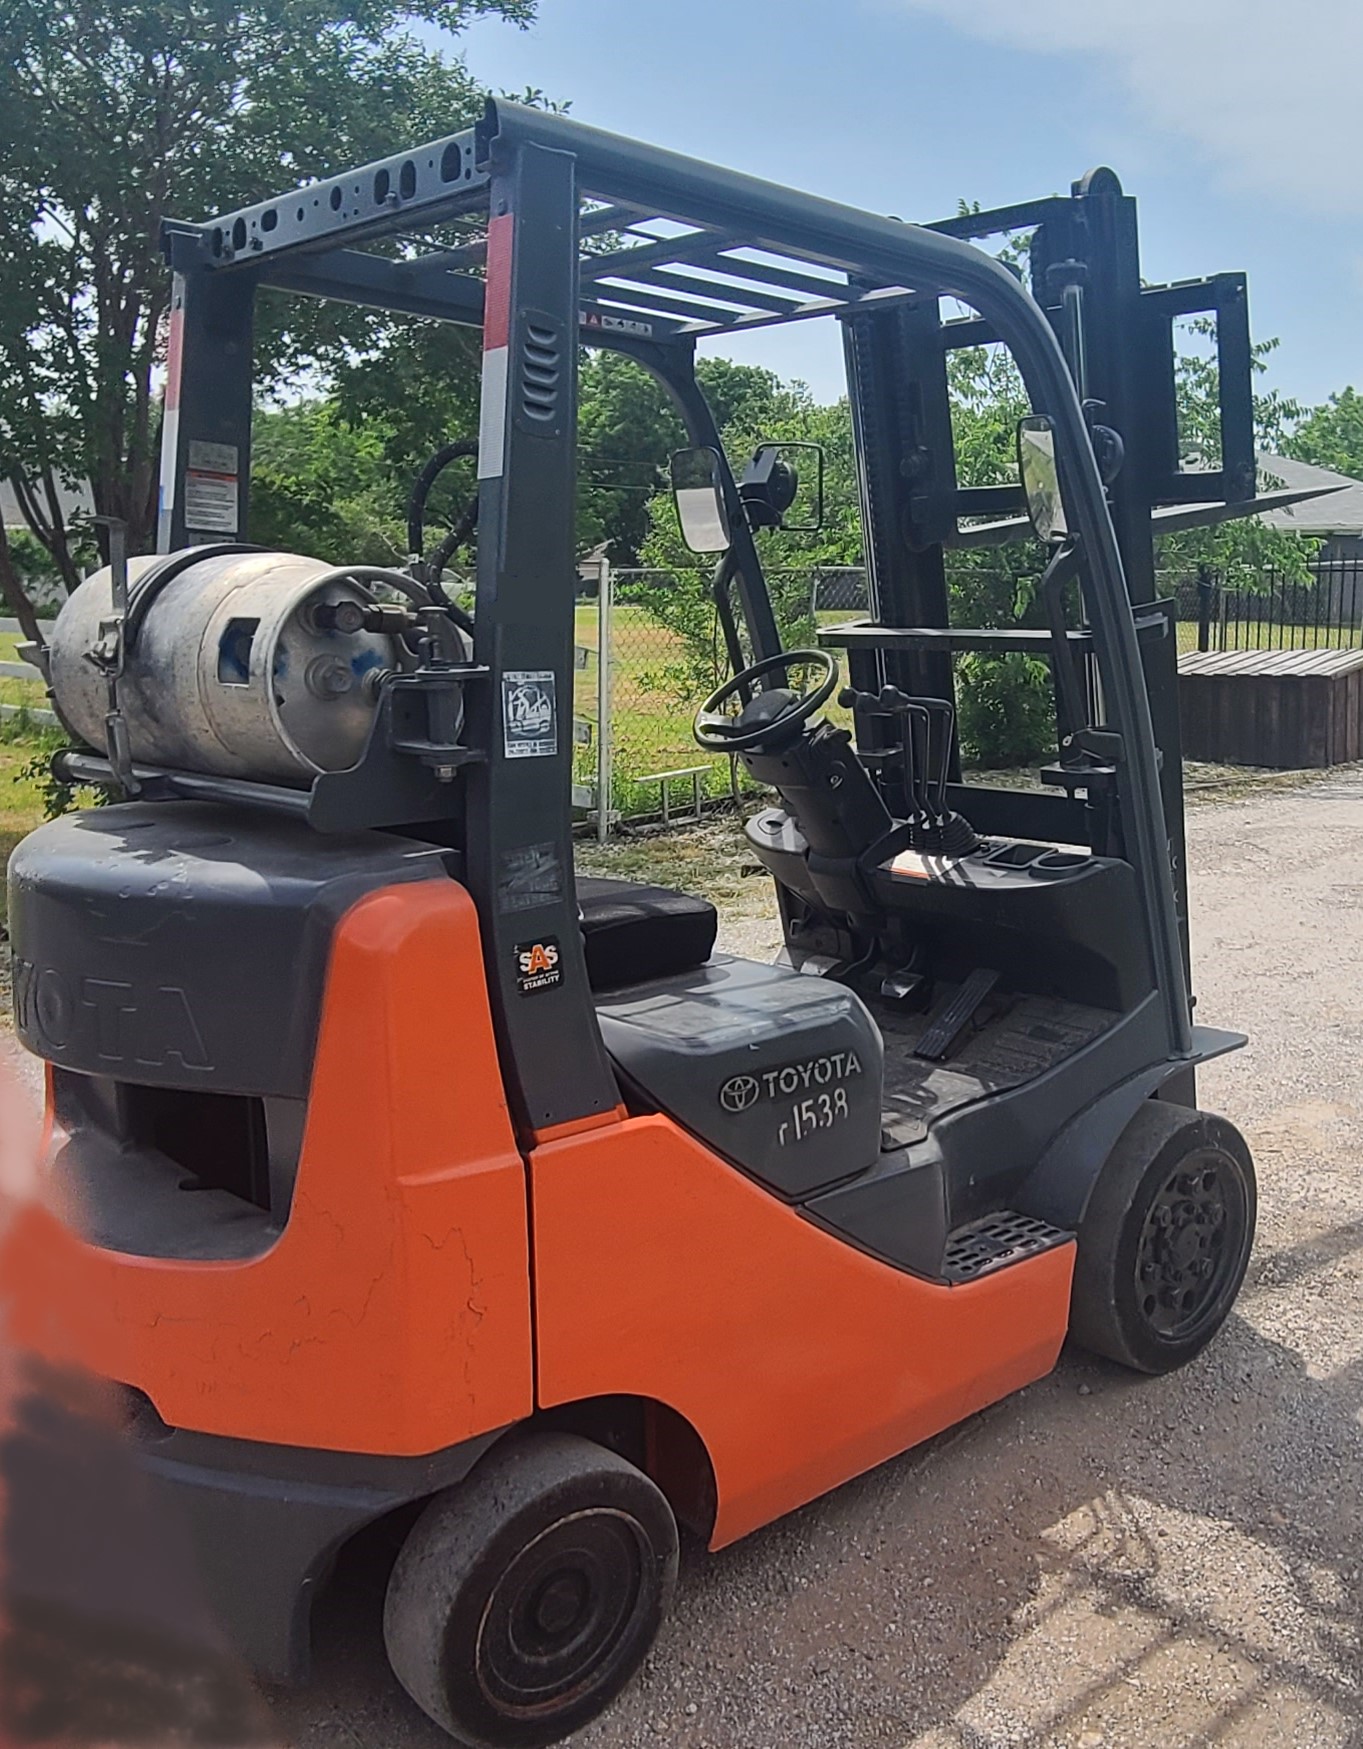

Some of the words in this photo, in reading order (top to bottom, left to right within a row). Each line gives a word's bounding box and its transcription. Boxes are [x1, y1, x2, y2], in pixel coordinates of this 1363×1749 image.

[519, 944, 559, 974] SAS
[523, 974, 560, 991] STABILITY
[762, 1051, 862, 1098] TOYOTA
